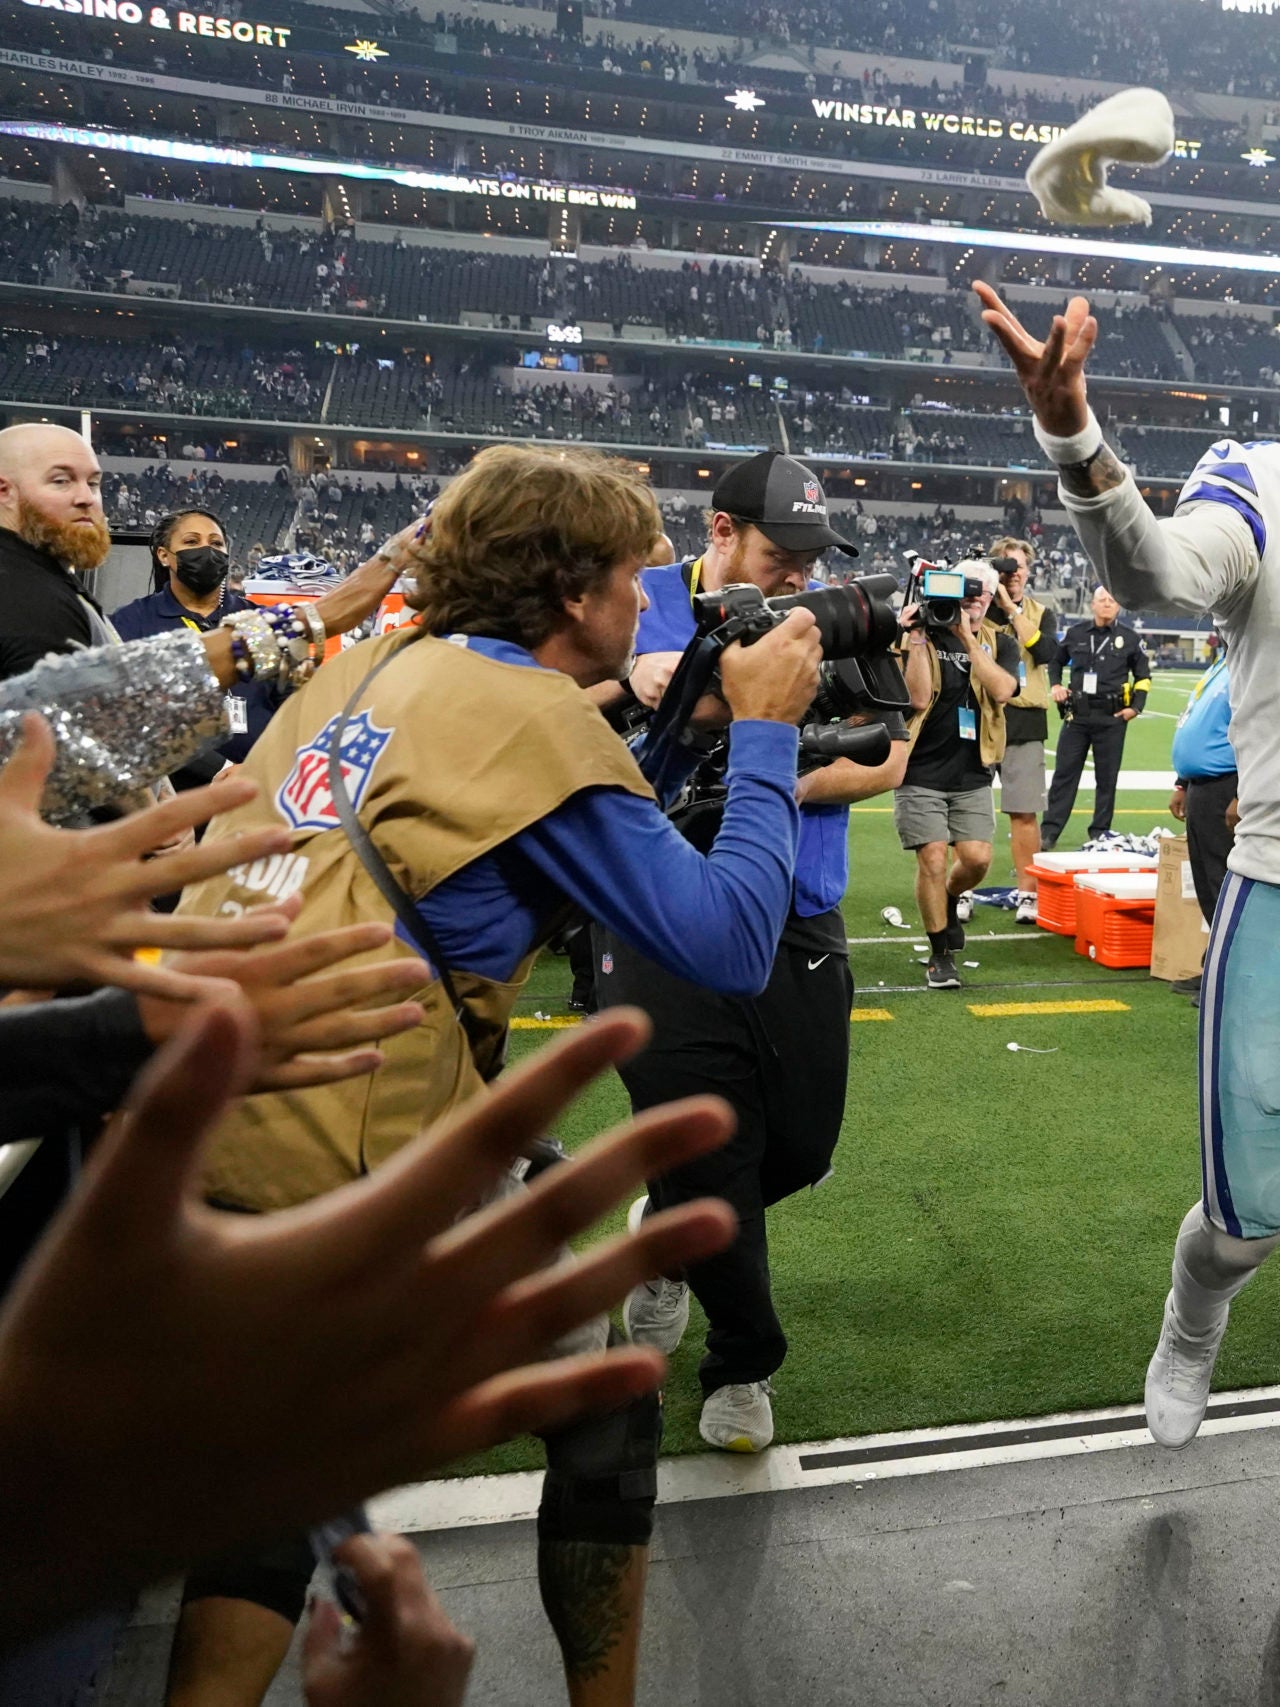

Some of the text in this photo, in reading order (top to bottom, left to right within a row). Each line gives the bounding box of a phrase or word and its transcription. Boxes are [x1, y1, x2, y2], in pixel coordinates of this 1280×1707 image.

[150, 7, 171, 30] &
[178, 11, 291, 48] RESORT
[59, 61, 104, 77] HALEY
[265, 93, 278, 104] 88
[282, 95, 333, 112] MICHAEL
[336, 104, 366, 115] IRVIN
[811, 98, 1068, 144] WINSTAR WORLD CASI
[519, 126, 547, 138] TROY
[548, 130, 587, 143] AIKMAN
[721, 150, 733, 160] 22
[735, 151, 774, 164] EMMITT
[777, 155, 808, 168] SMITH
[921, 170, 932, 181] 73
[936, 173, 967, 184] LARRY
[971, 176, 1002, 187] ALLEN
[501, 182, 530, 200] ON
[532, 185, 566, 203] THE
[568, 189, 598, 207] BIG
[600, 193, 637, 210] WIN
[227, 852, 310, 902] DIA
